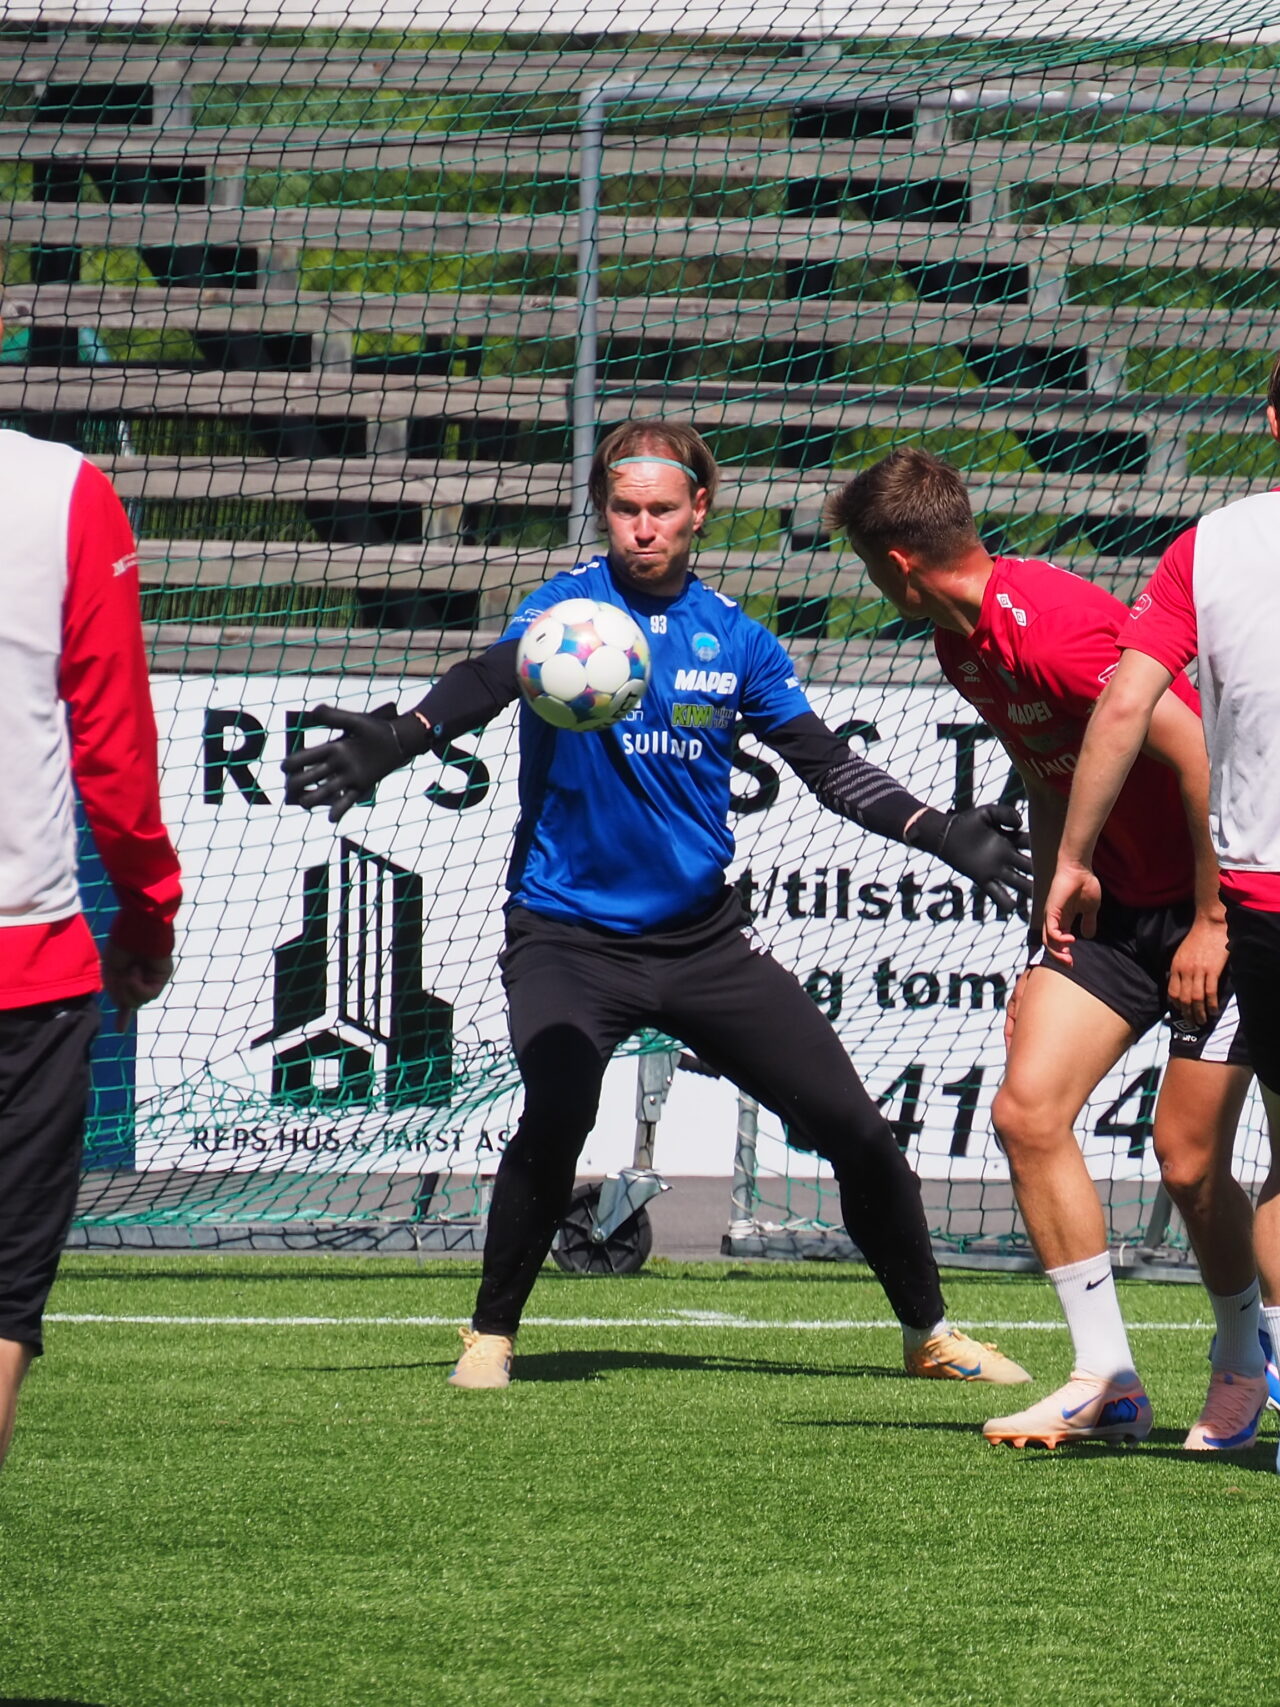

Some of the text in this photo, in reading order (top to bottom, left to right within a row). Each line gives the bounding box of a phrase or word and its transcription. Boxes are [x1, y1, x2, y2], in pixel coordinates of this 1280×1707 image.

[650, 615, 668, 635] 93
[671, 702, 715, 728] KIWI
[1007, 701, 1054, 725] MAPEI
[873, 956, 1022, 1011] tøm
[193, 1127, 267, 1152] REPS
[278, 1128, 341, 1152] HUS
